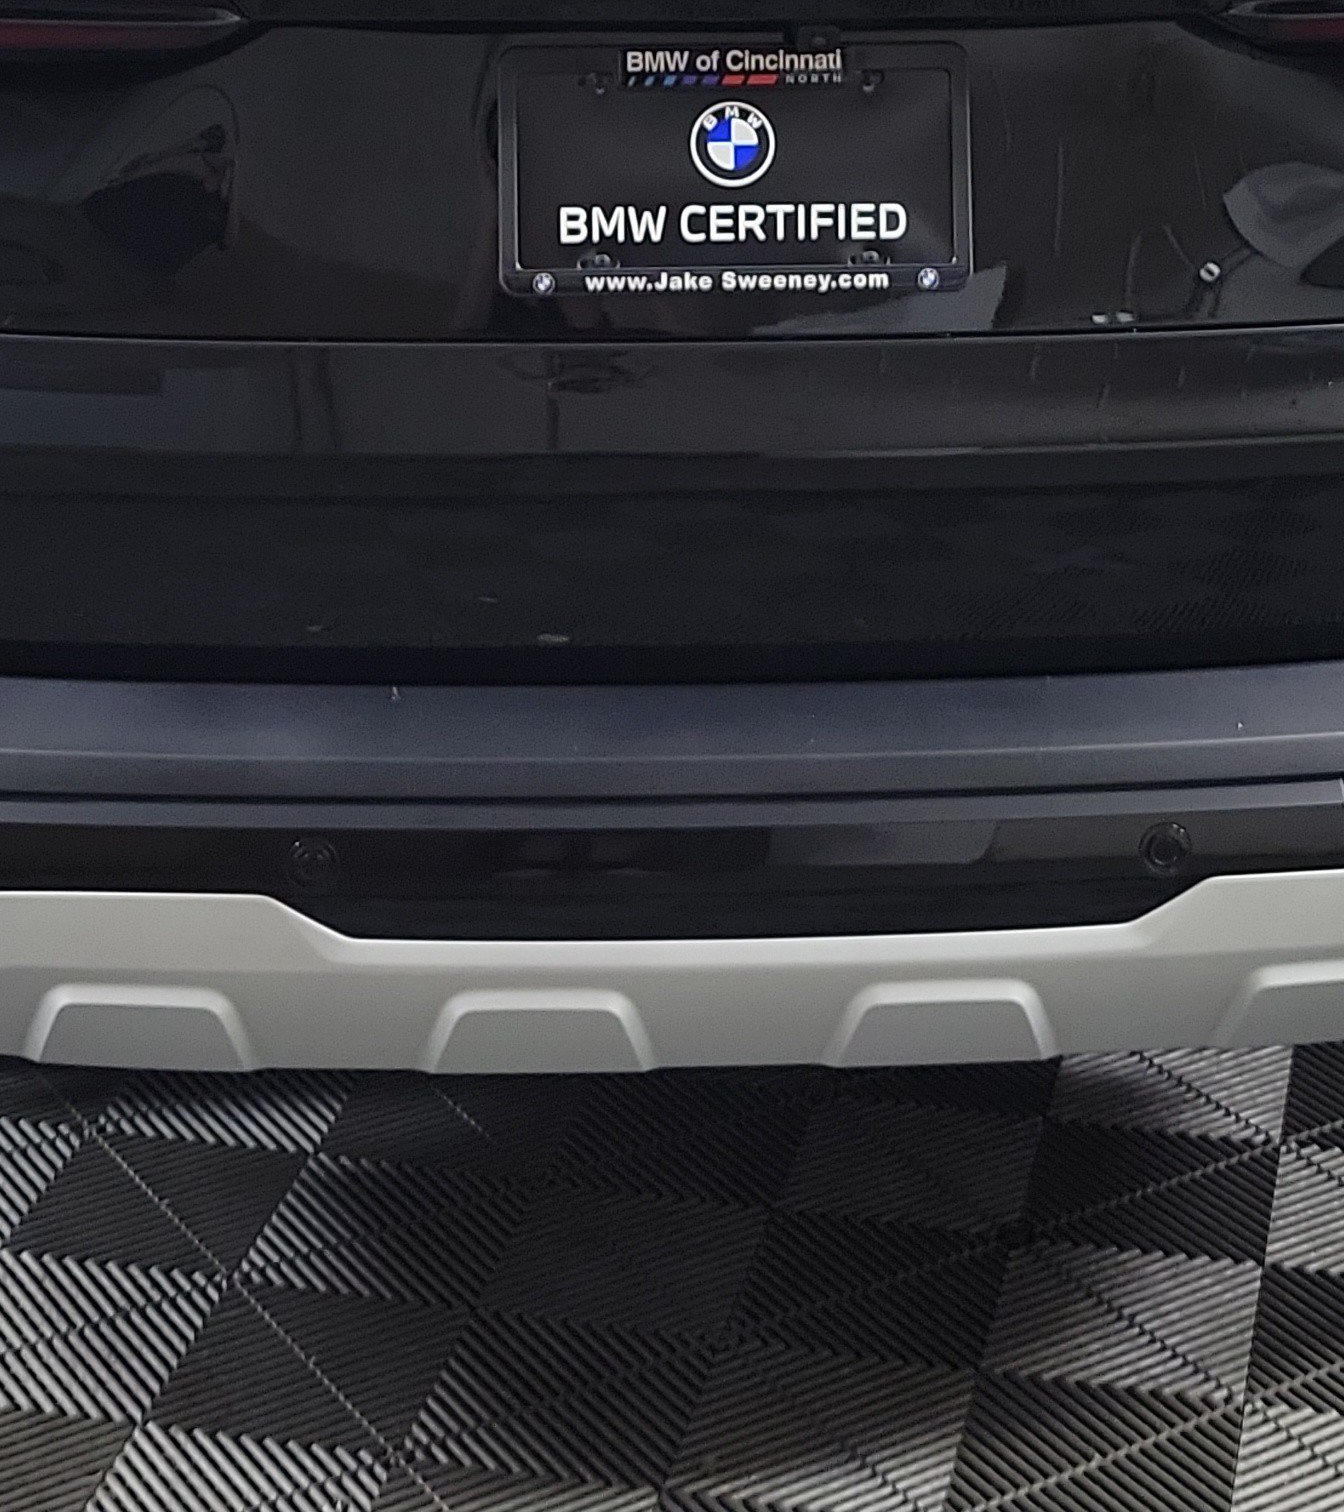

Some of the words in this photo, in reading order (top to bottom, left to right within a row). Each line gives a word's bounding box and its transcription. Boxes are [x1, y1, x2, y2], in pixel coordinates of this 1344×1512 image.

[625, 50, 689, 73] BMW
[695, 49, 720, 71] of
[725, 48, 842, 72] Cincinnati
[785, 72, 842, 85] NORTH
[702, 105, 763, 131] BMW
[559, 206, 667, 244] BMW
[680, 202, 907, 242] CERTIFIED
[585, 271, 713, 292] www.Jake
[721, 270, 890, 293] Sweeney.com
